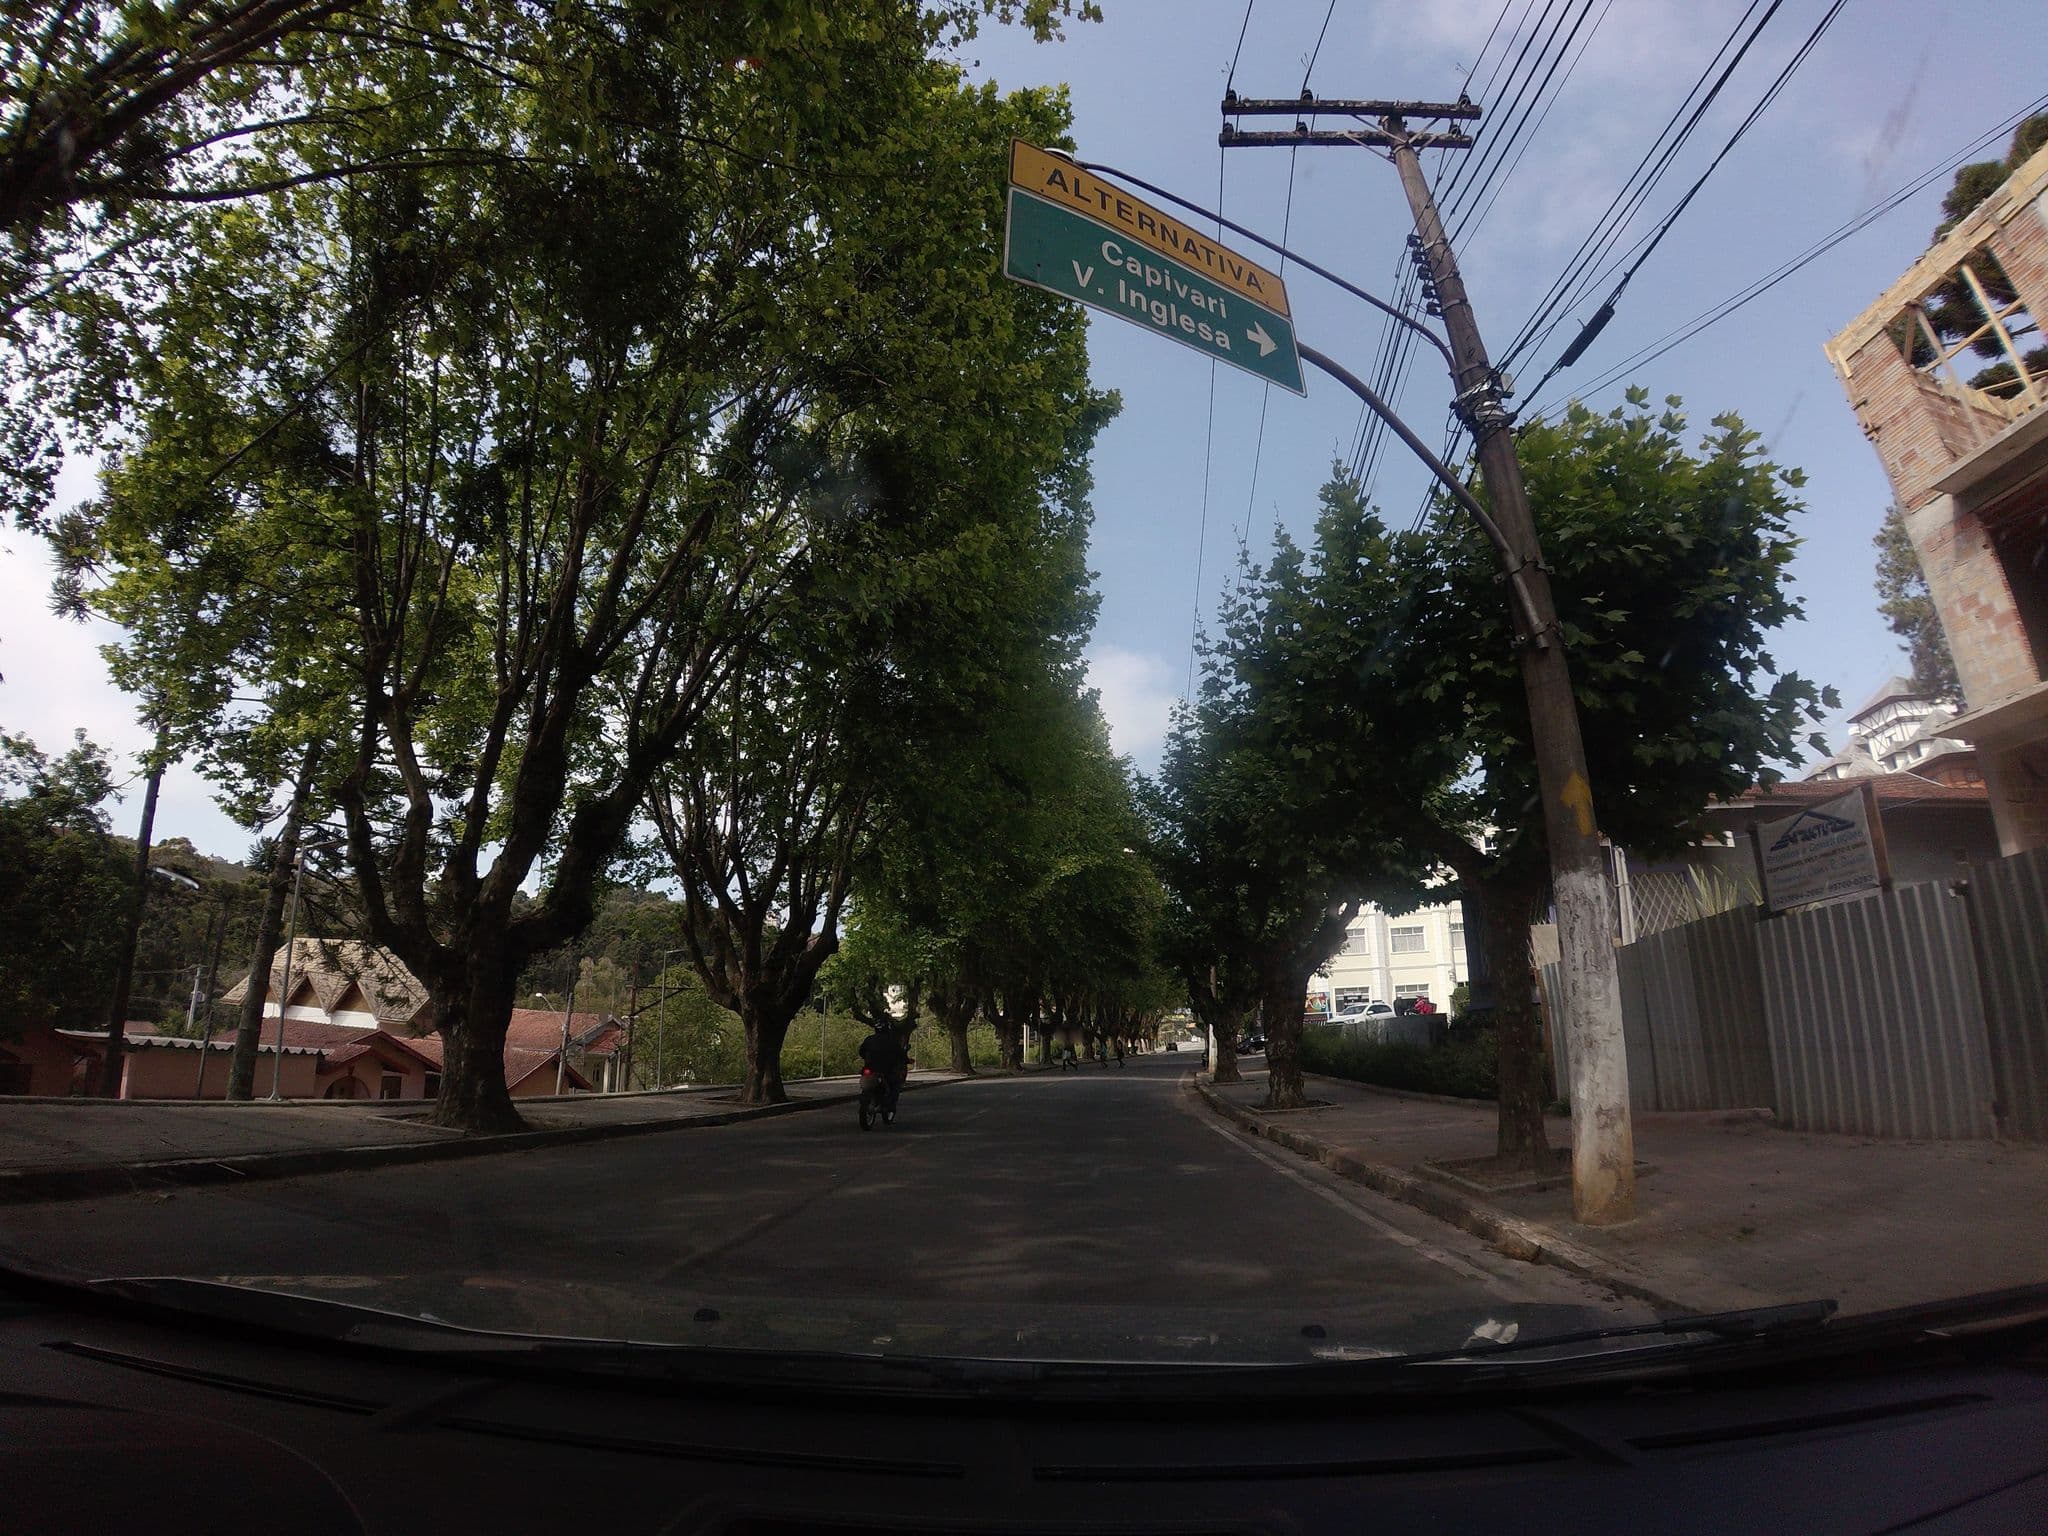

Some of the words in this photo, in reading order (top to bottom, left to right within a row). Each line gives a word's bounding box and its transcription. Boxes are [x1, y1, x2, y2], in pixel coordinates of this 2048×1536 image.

[1046, 167, 1264, 293] ALTERNATIVA
[1072, 260, 1104, 294] V.
[1119, 279, 1231, 350] Inglesa
[1101, 240, 1227, 319] Capivari
